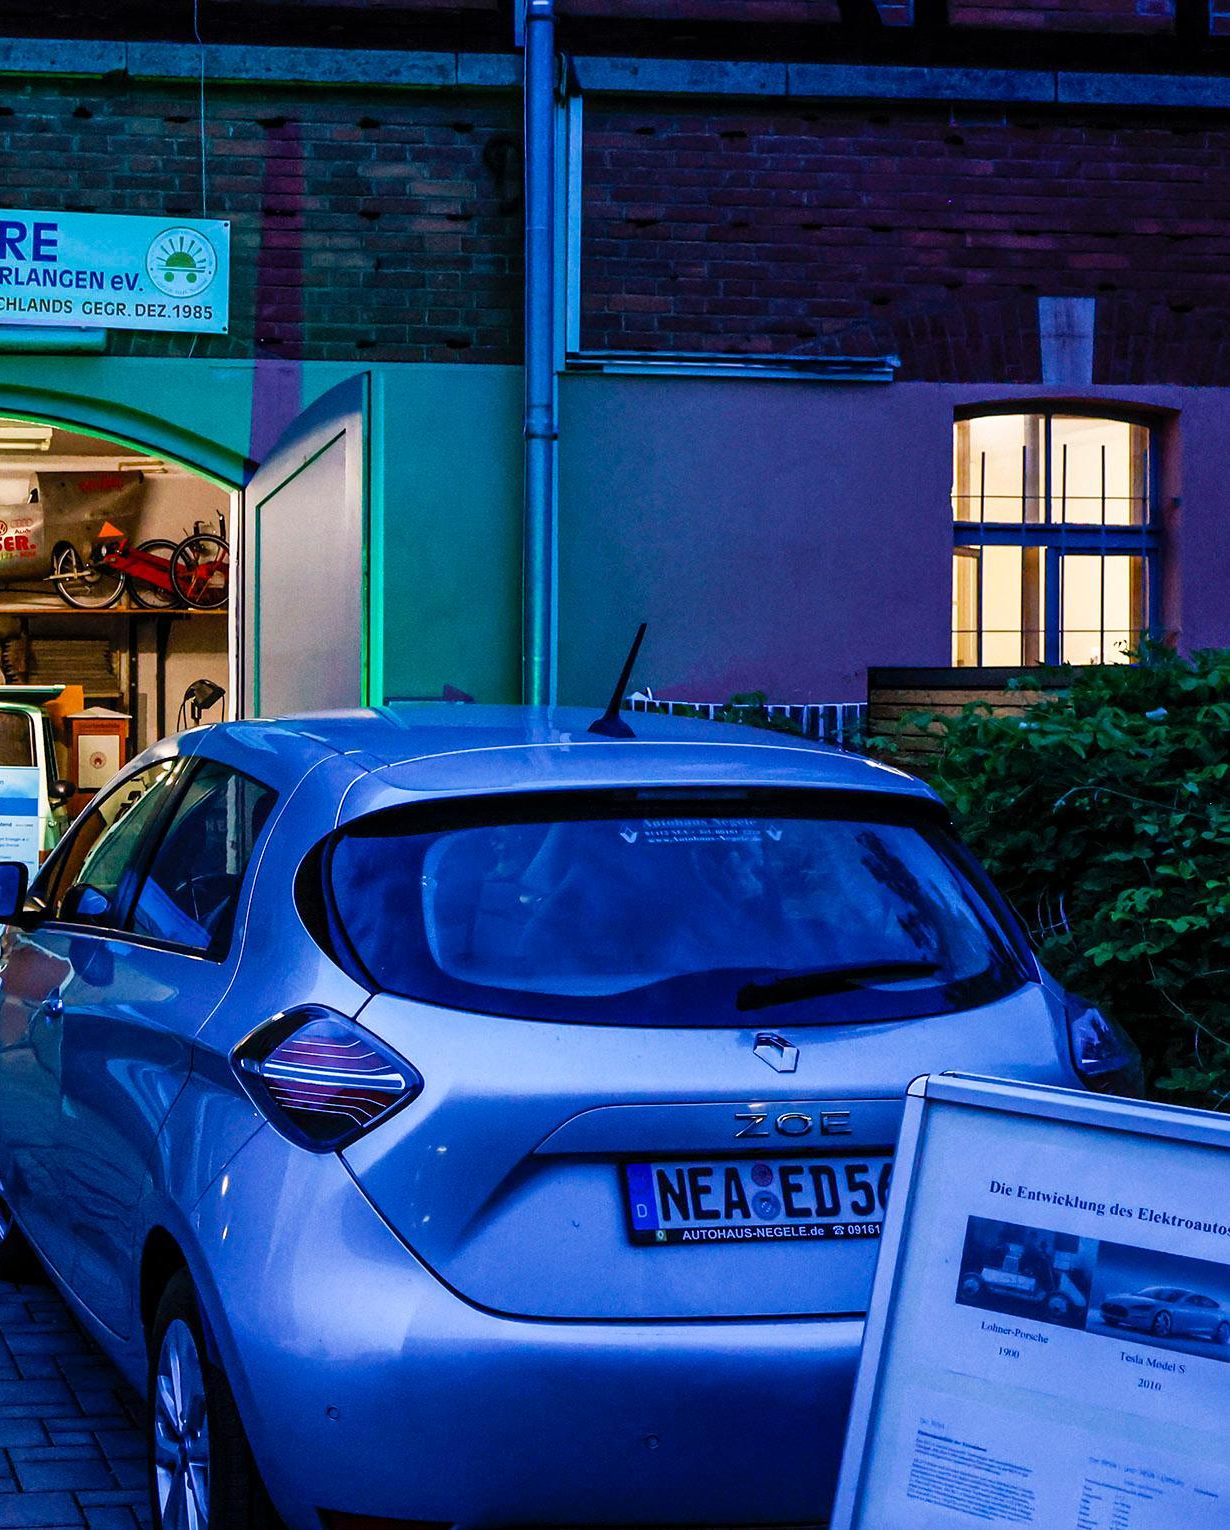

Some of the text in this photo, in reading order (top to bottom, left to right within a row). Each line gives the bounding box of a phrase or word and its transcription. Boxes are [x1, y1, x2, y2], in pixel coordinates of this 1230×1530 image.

[109, 272, 144, 292] eV.
[81, 300, 131, 318] GEGR.
[643, 818, 757, 828] Autohaus Negele
[734, 1110, 853, 1138] ZOE
[656, 1165, 751, 1222] NEA
[778, 1165, 841, 1218] ED
[989, 1180, 1013, 1196] Die
[1017, 1185, 1106, 1216] Entwicklung
[1109, 1203, 1133, 1219] des
[636, 1203, 648, 1218] D
[682, 1224, 881, 1241] AUTOHAUS-NEGELE.de 09161
[981, 1321, 1049, 1345] Lohner-Porsche
[998, 1346, 1020, 1360] 1900
[1120, 1351, 1187, 1374] Tesla Model S
[1137, 1378, 1163, 1392] 2010
